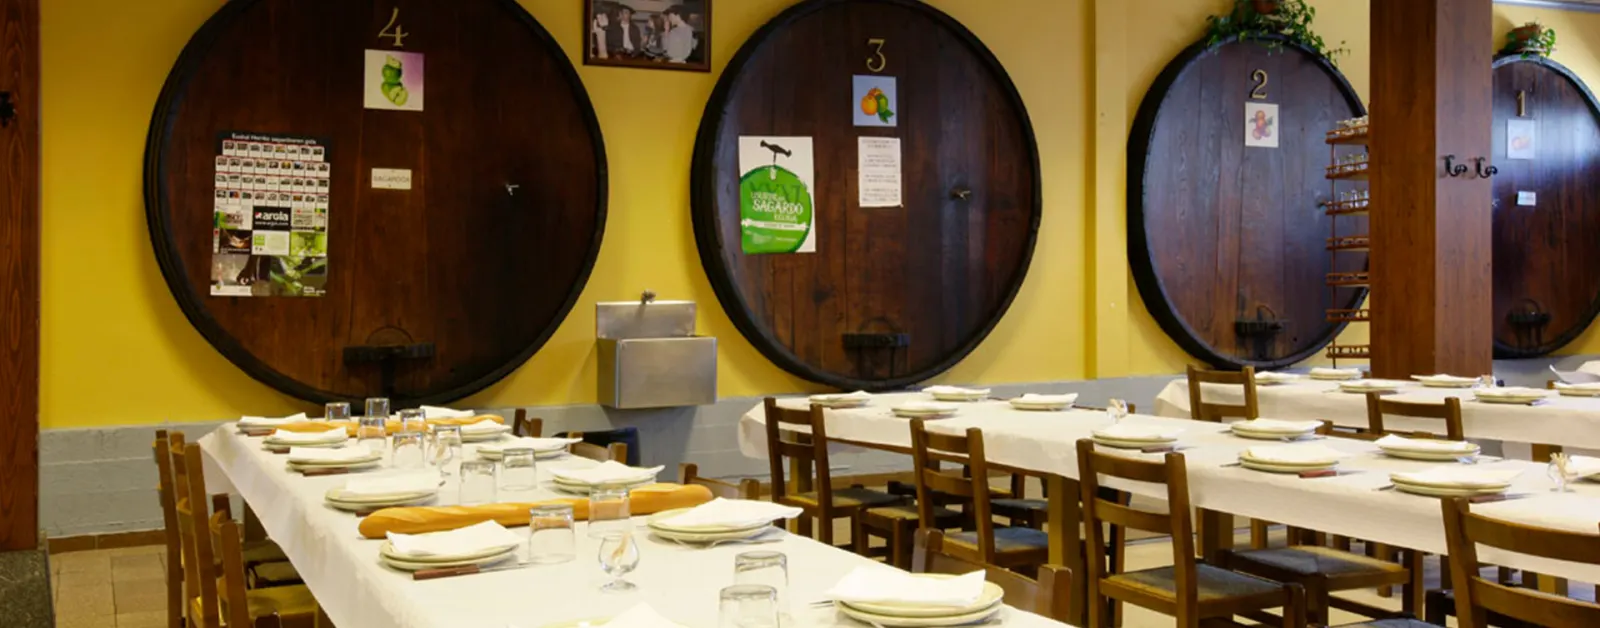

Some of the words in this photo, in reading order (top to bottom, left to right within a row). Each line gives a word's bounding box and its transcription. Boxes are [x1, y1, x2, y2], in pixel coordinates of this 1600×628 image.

[378, 6, 409, 47] 4
[866, 38, 886, 72] 3
[1252, 69, 1268, 99] 2
[1517, 89, 1526, 116] 1
[752, 198, 804, 216] SAGARDO
